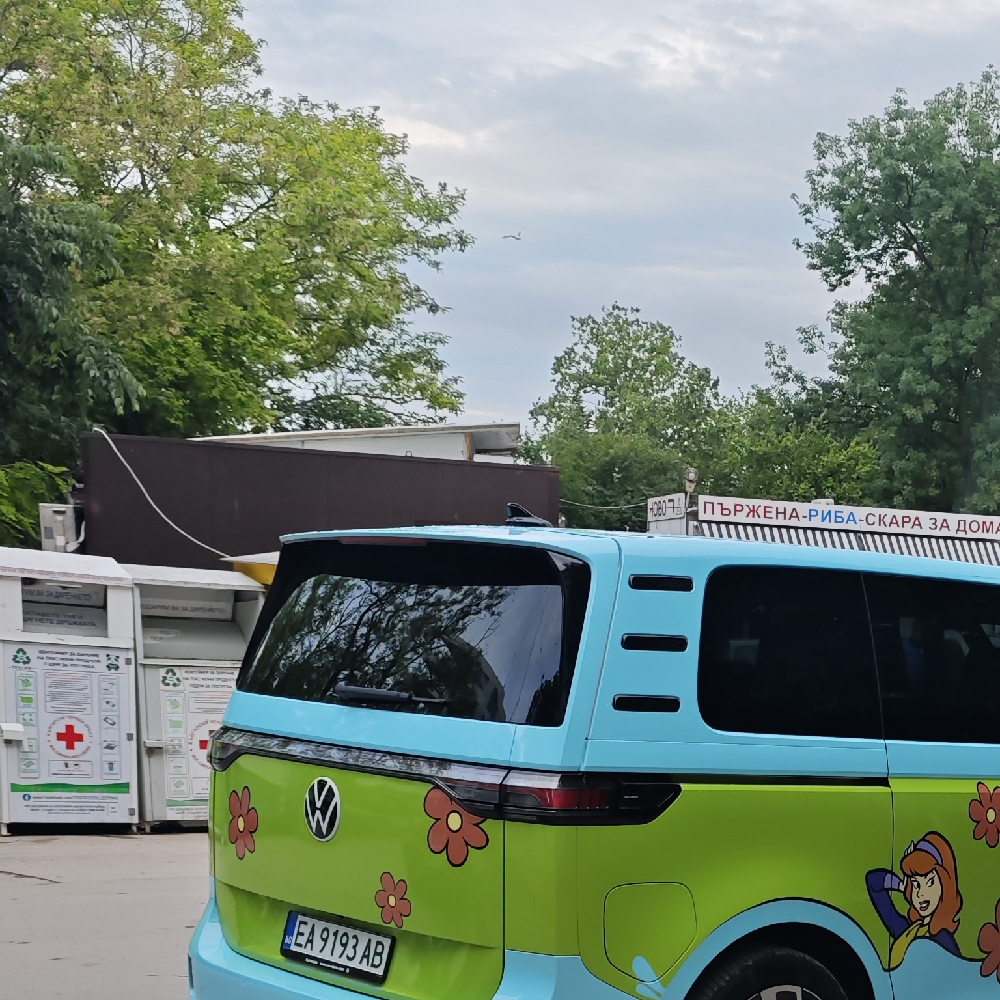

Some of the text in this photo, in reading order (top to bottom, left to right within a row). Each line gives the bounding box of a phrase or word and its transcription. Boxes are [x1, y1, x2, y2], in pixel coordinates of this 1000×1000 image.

[703, 501, 923, 530] ПЪРЖЕНА-РИБА-СКАРА
[928, 516, 951, 532] ЗА
[293, 920, 316, 951] EA
[318, 926, 359, 962] 9193
[358, 938, 385, 969] AB
